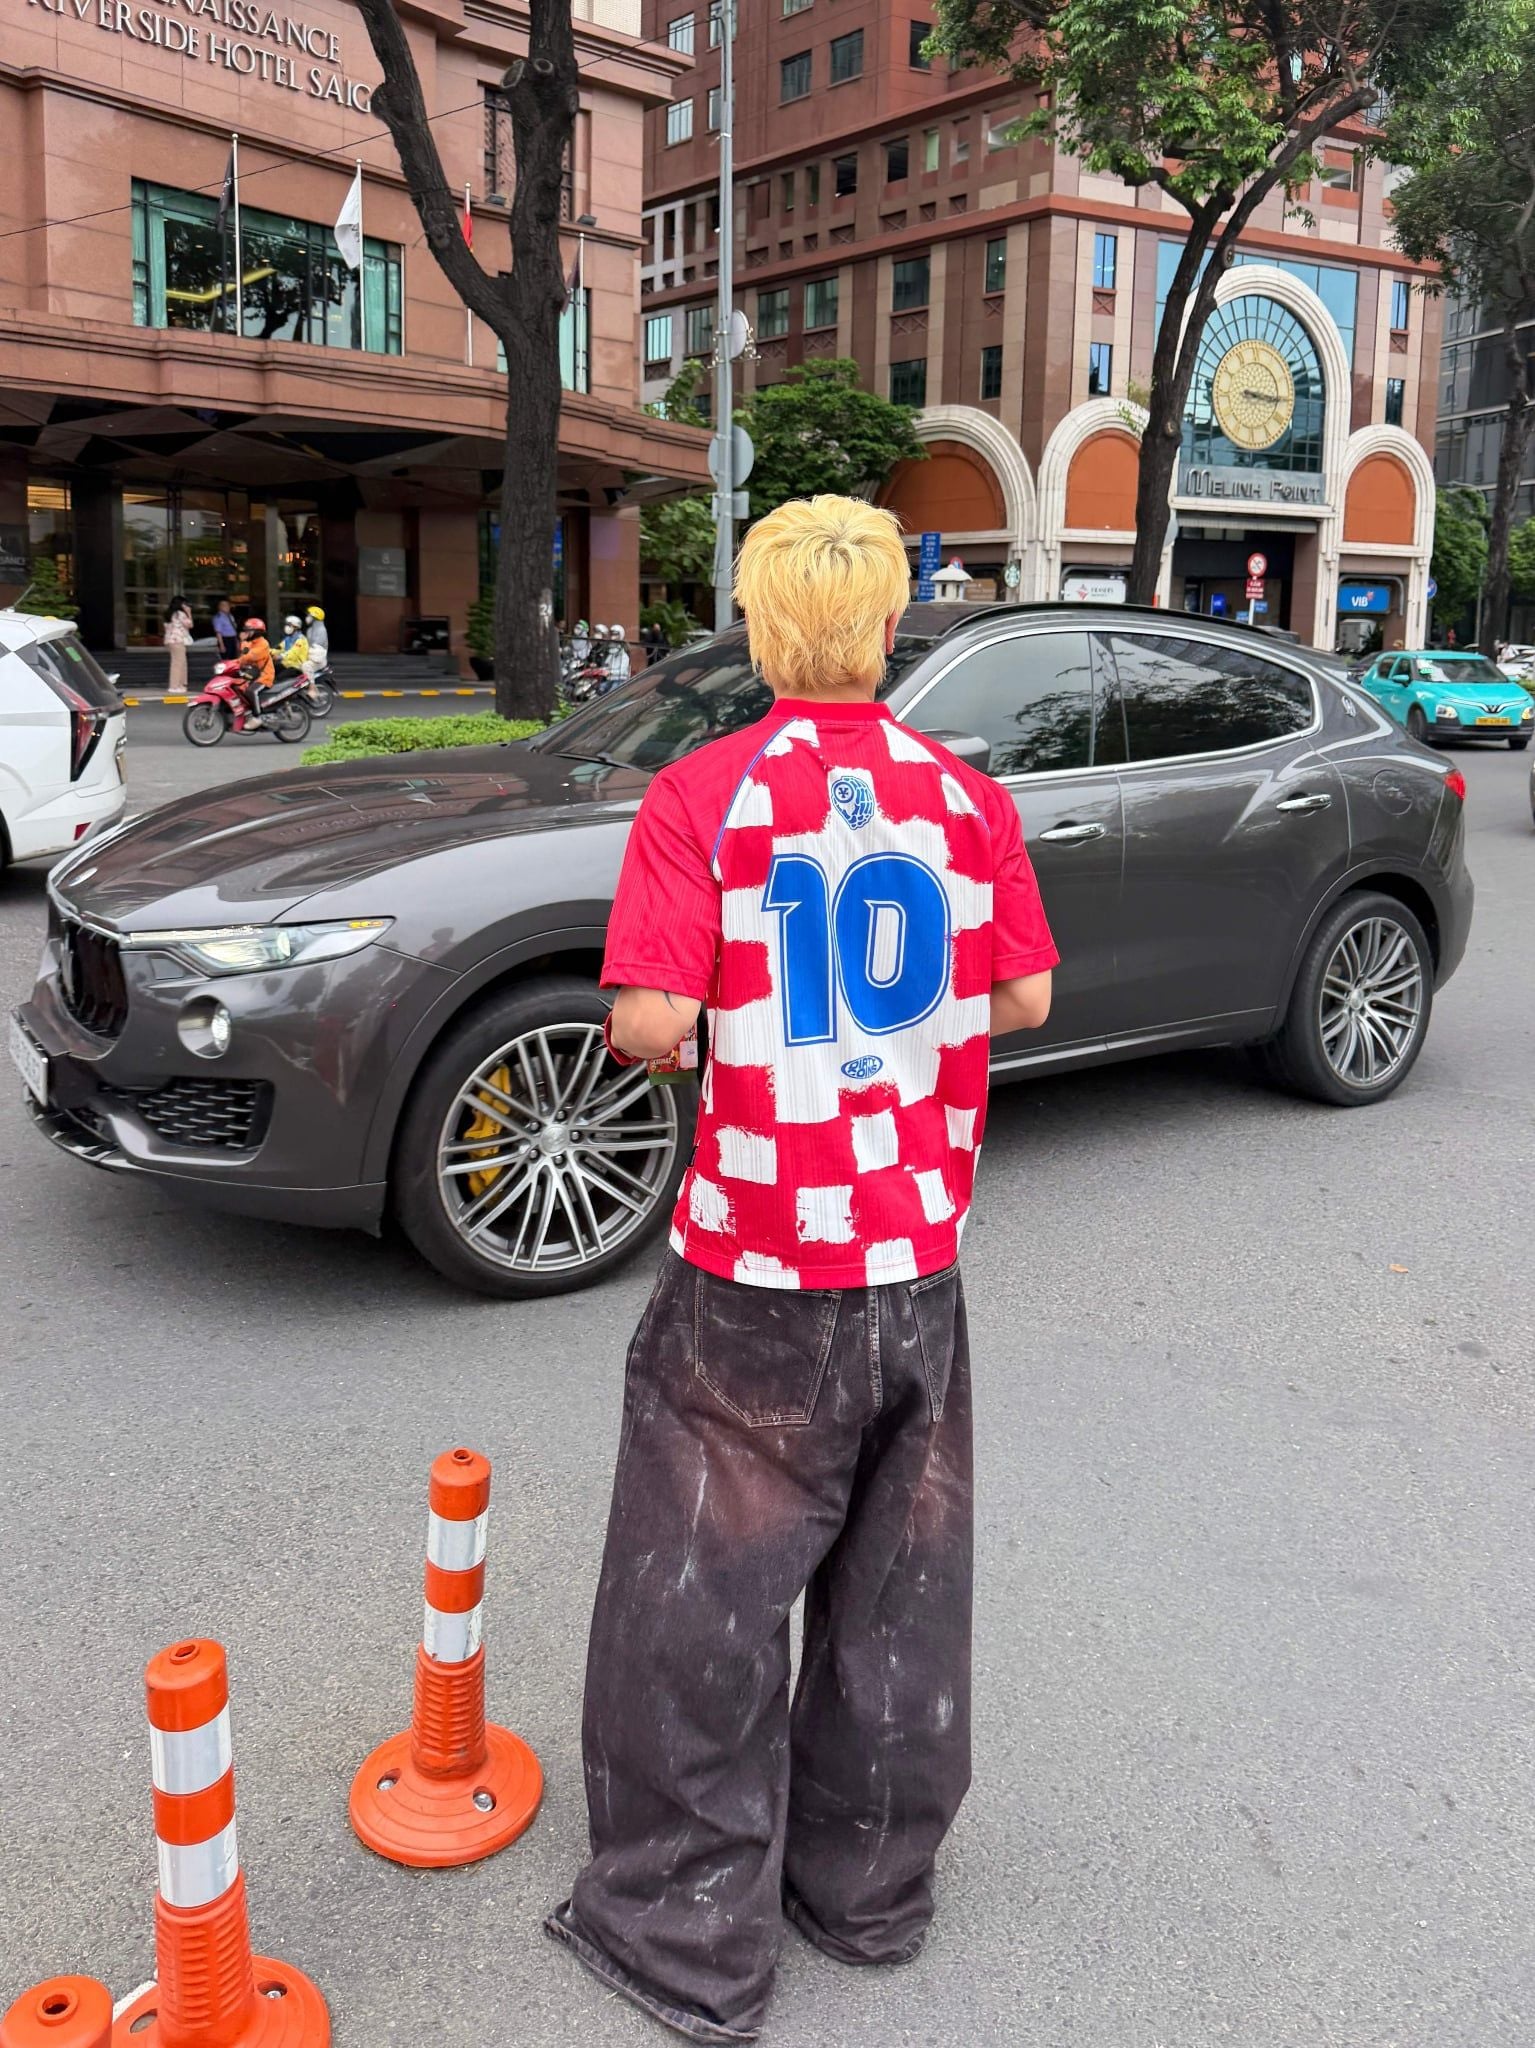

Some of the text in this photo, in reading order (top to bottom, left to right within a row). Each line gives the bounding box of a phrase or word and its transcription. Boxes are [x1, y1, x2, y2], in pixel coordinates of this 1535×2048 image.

[210, 32, 304, 89] HOTEL
[1351, 596, 1368, 607] VIB
[761, 852, 951, 1047] 10
